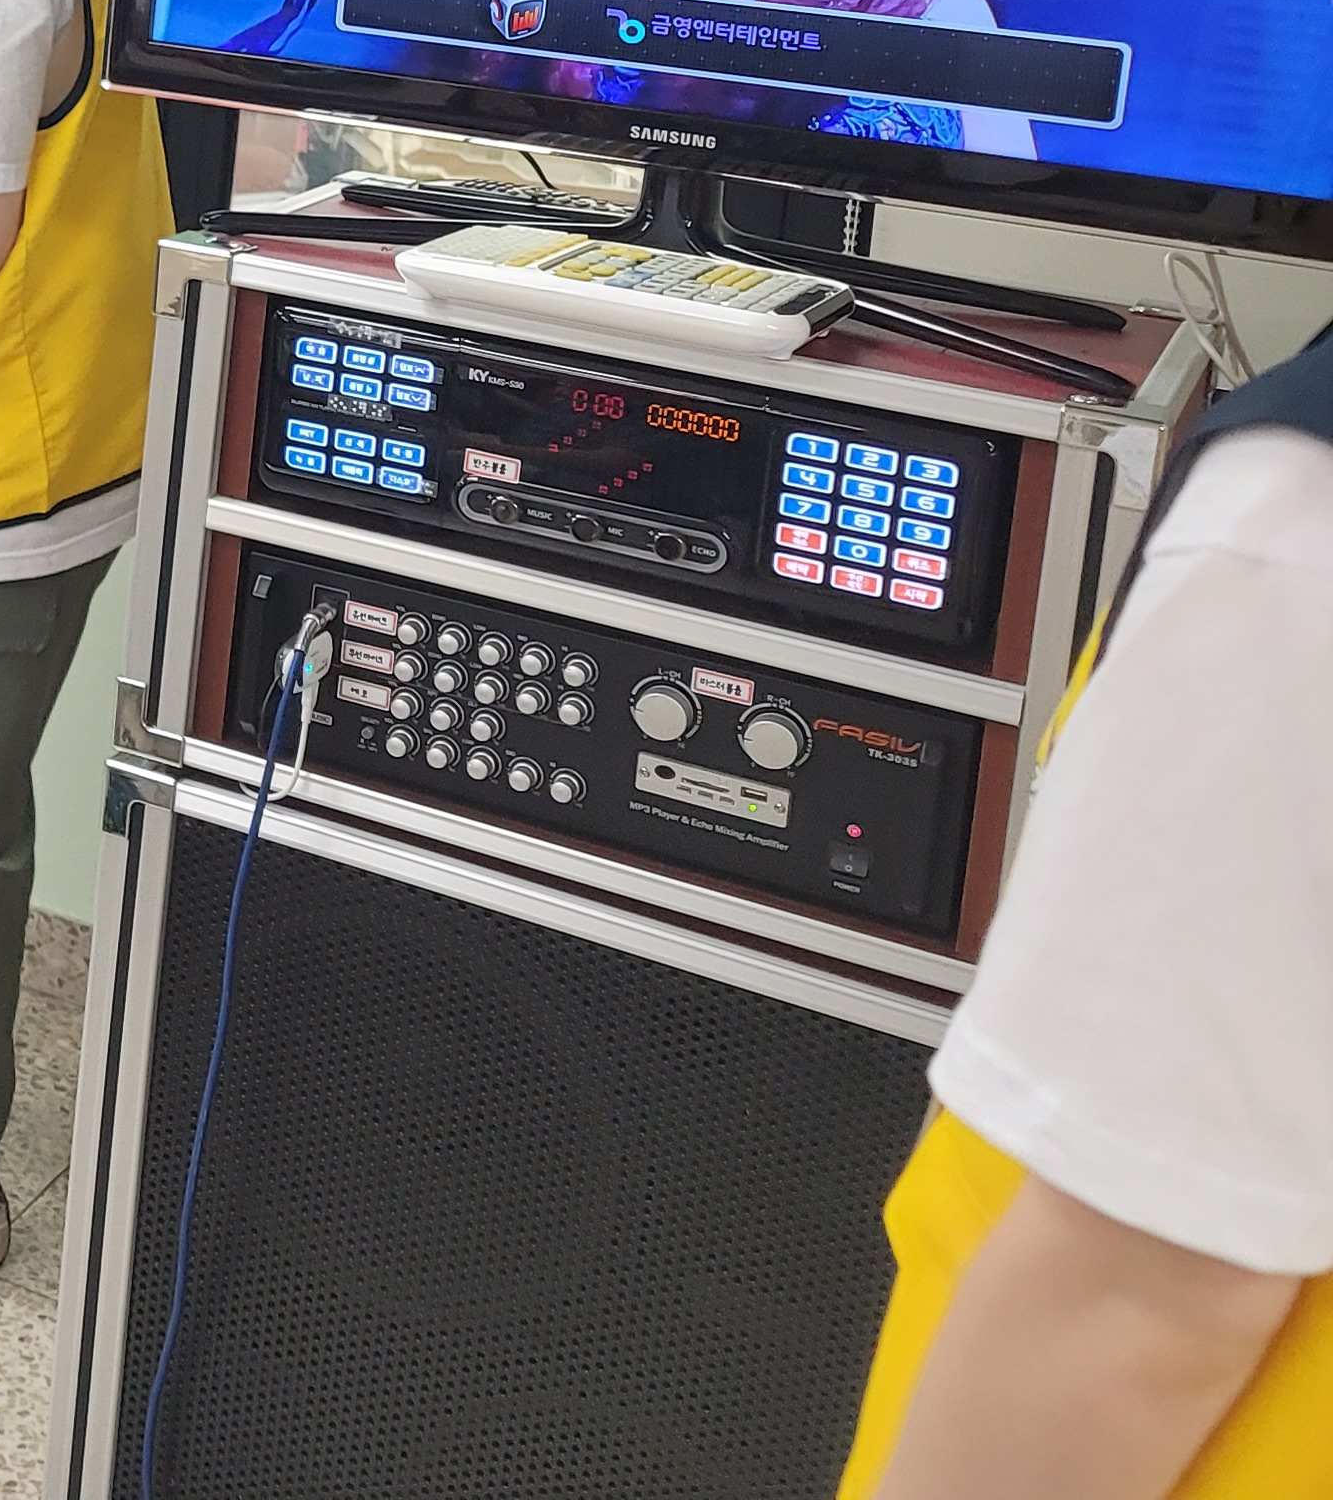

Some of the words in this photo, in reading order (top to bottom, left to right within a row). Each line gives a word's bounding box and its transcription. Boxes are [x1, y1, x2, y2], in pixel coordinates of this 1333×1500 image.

[650, 13, 822, 51] 금영엔터테인먼트
[629, 125, 717, 150] SAMSUNG
[468, 367, 490, 382] KY
[646, 403, 740, 442] 000000
[808, 441, 818, 454] 1
[862, 453, 880, 467] 2
[799, 470, 817, 486] 4
[922, 464, 940, 479] 3
[858, 484, 876, 498] 5
[797, 501, 812, 515] 7
[917, 496, 935, 510] 6
[527, 507, 553, 521] MUSIC
[854, 514, 872, 528] 8
[608, 526, 623, 537] MIC
[914, 526, 932, 541] 9
[691, 545, 717, 558] ECHO
[851, 545, 868, 558] 0
[658, 668, 681, 680] L-CH
[767, 695, 791, 707] R-CH
[868, 748, 918, 768] TK-303S
[629, 801, 650, 814] MP3
[652, 808, 680, 822] Player
[681, 814, 689, 825] &
[691, 818, 713, 831] Echo
[715, 825, 745, 841] Mixing
[746, 833, 790, 851] Amplifier
